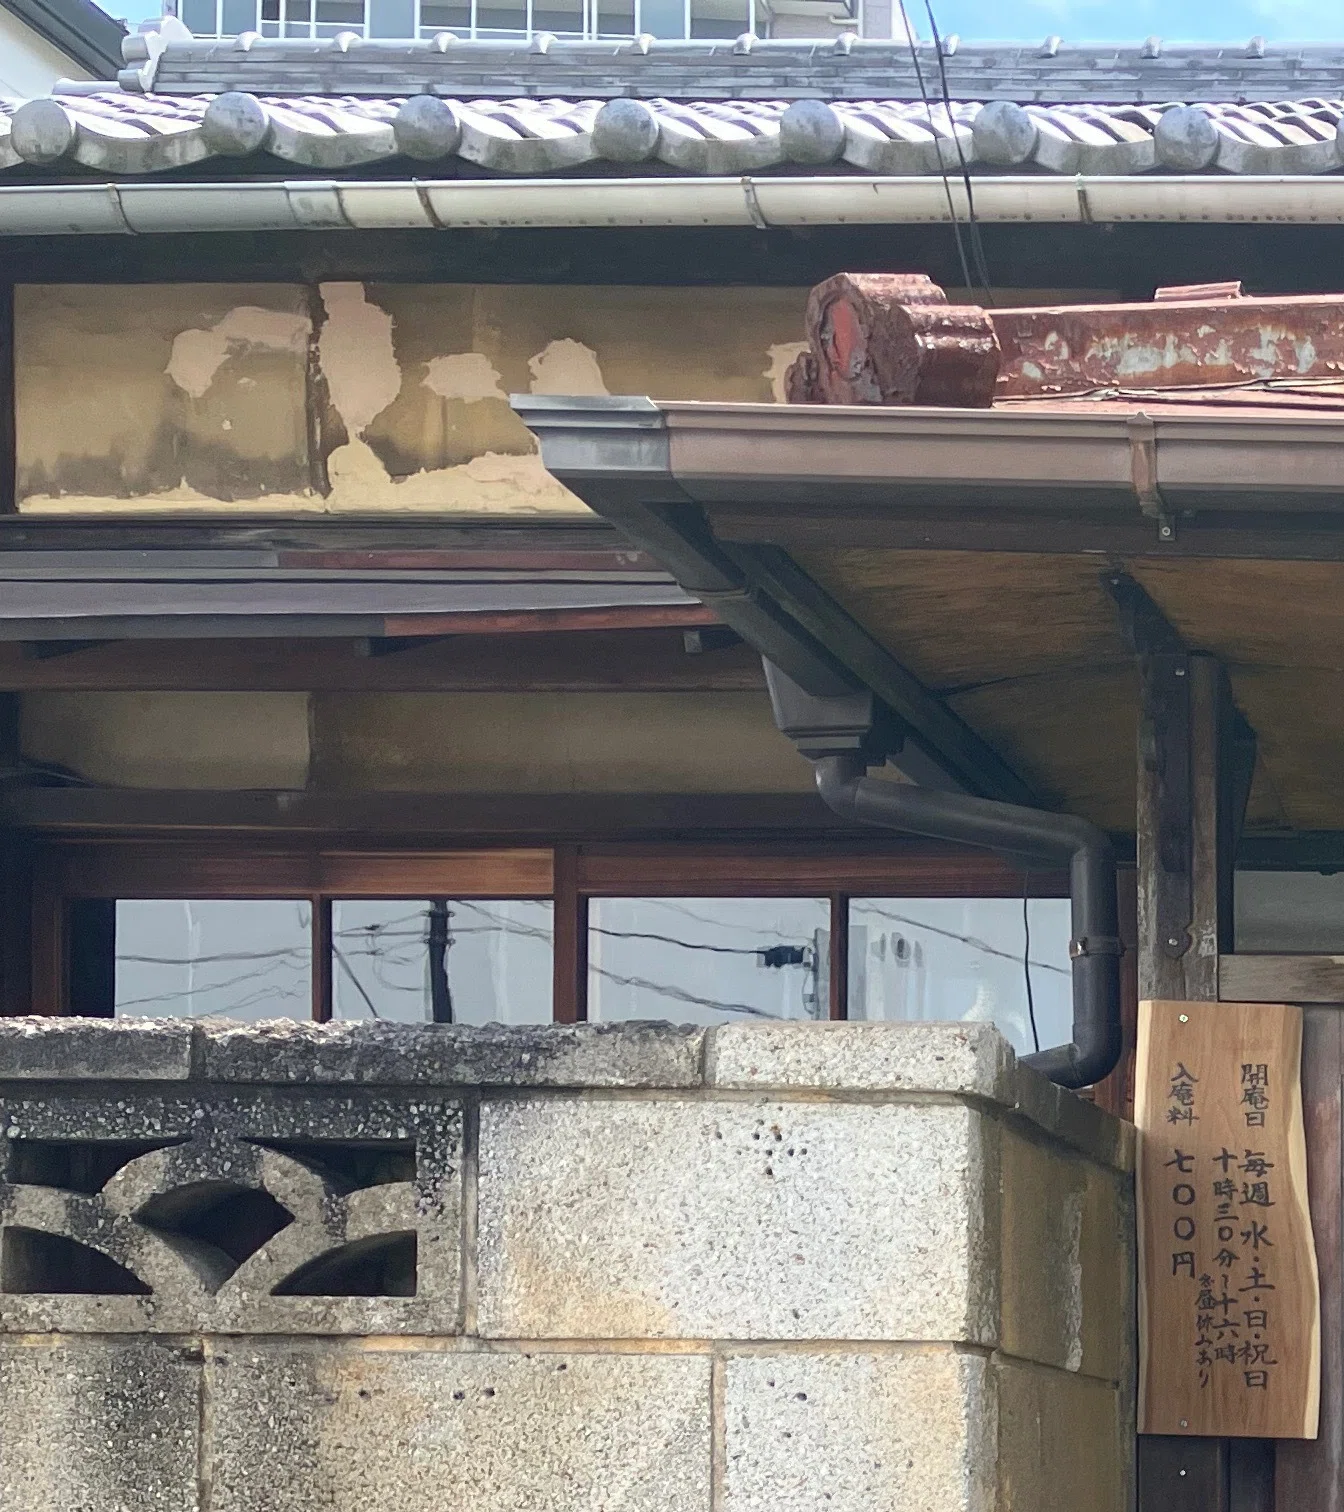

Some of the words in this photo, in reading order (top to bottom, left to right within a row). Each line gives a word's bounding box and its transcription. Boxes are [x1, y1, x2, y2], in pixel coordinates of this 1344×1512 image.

[1166, 1061, 1200, 1127] 入庵料
[1240, 1063, 1270, 1128] 開庵日
